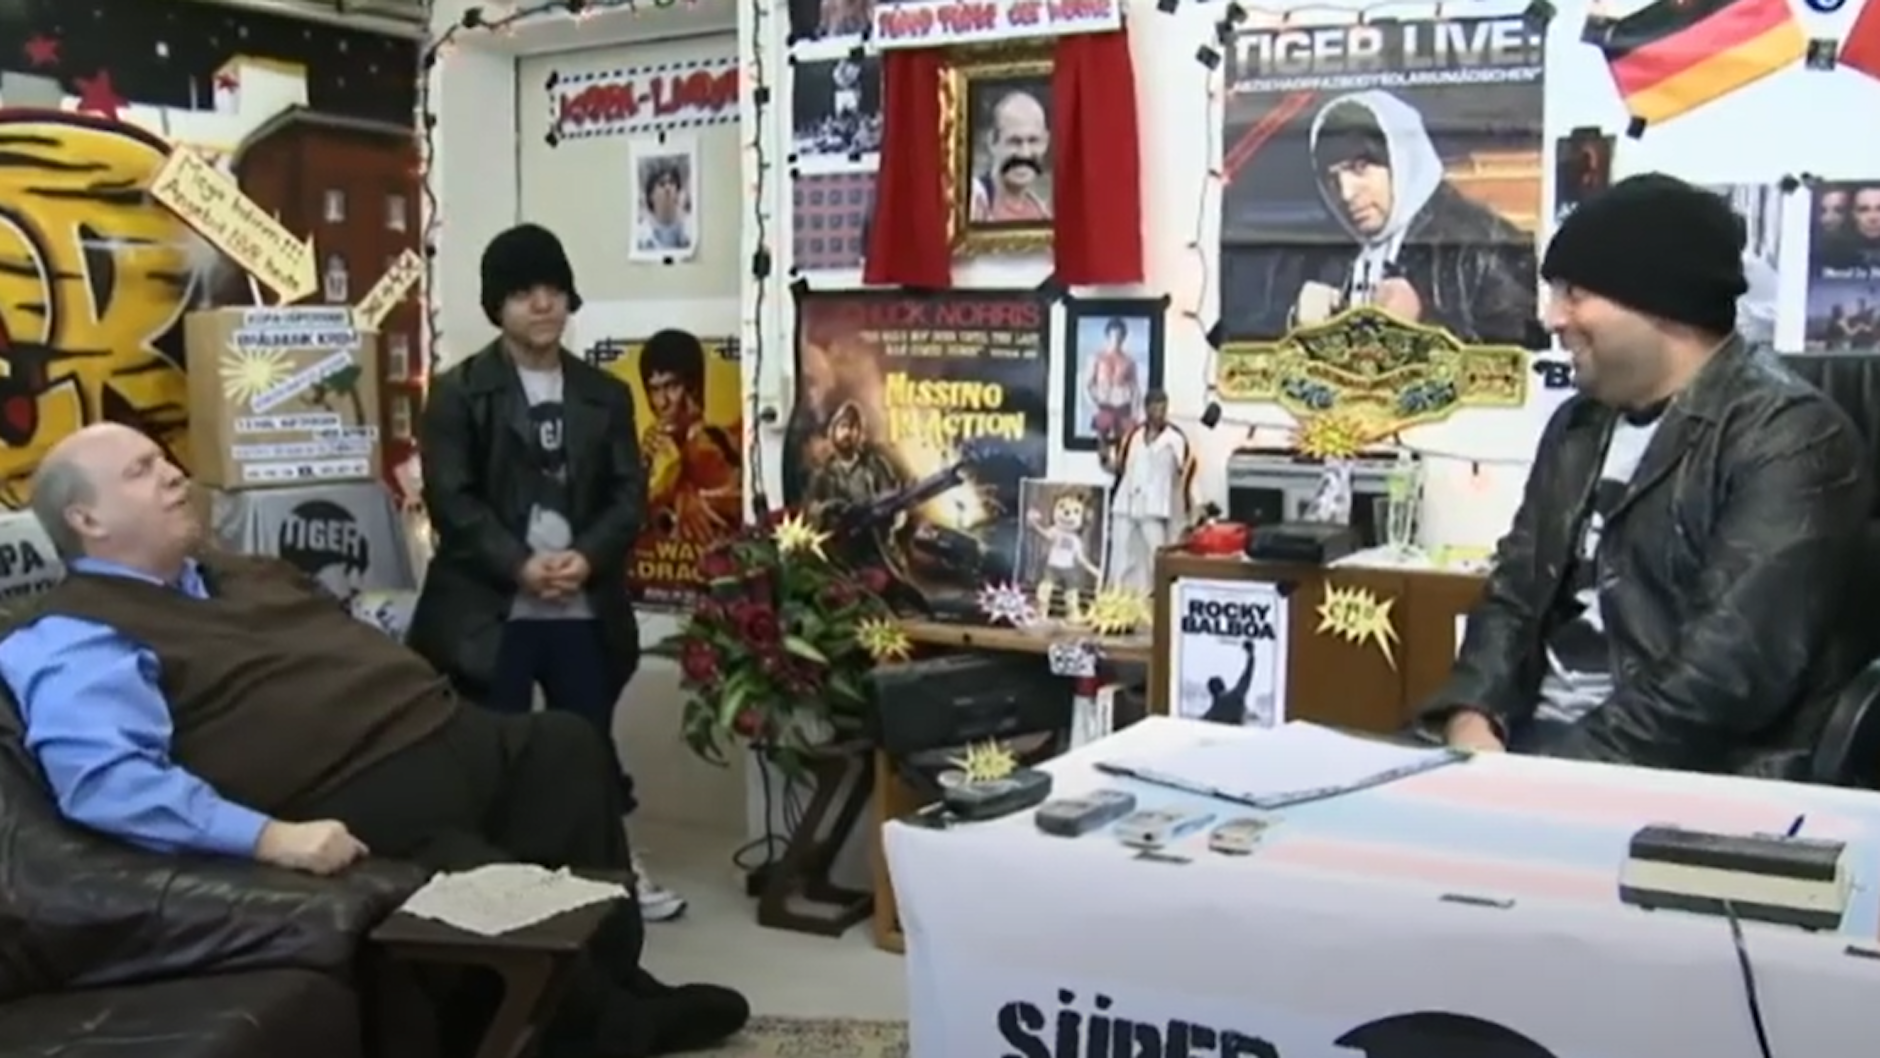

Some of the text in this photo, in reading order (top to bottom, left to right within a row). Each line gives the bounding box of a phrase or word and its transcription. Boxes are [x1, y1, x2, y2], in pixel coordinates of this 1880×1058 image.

[1235, 26, 1384, 77] TIGER
[936, 301, 1041, 327] NORRIS
[283, 517, 360, 559] TIGER
[1188, 599, 1271, 621] ROCKY
[1181, 616, 1276, 640] BALBOA
